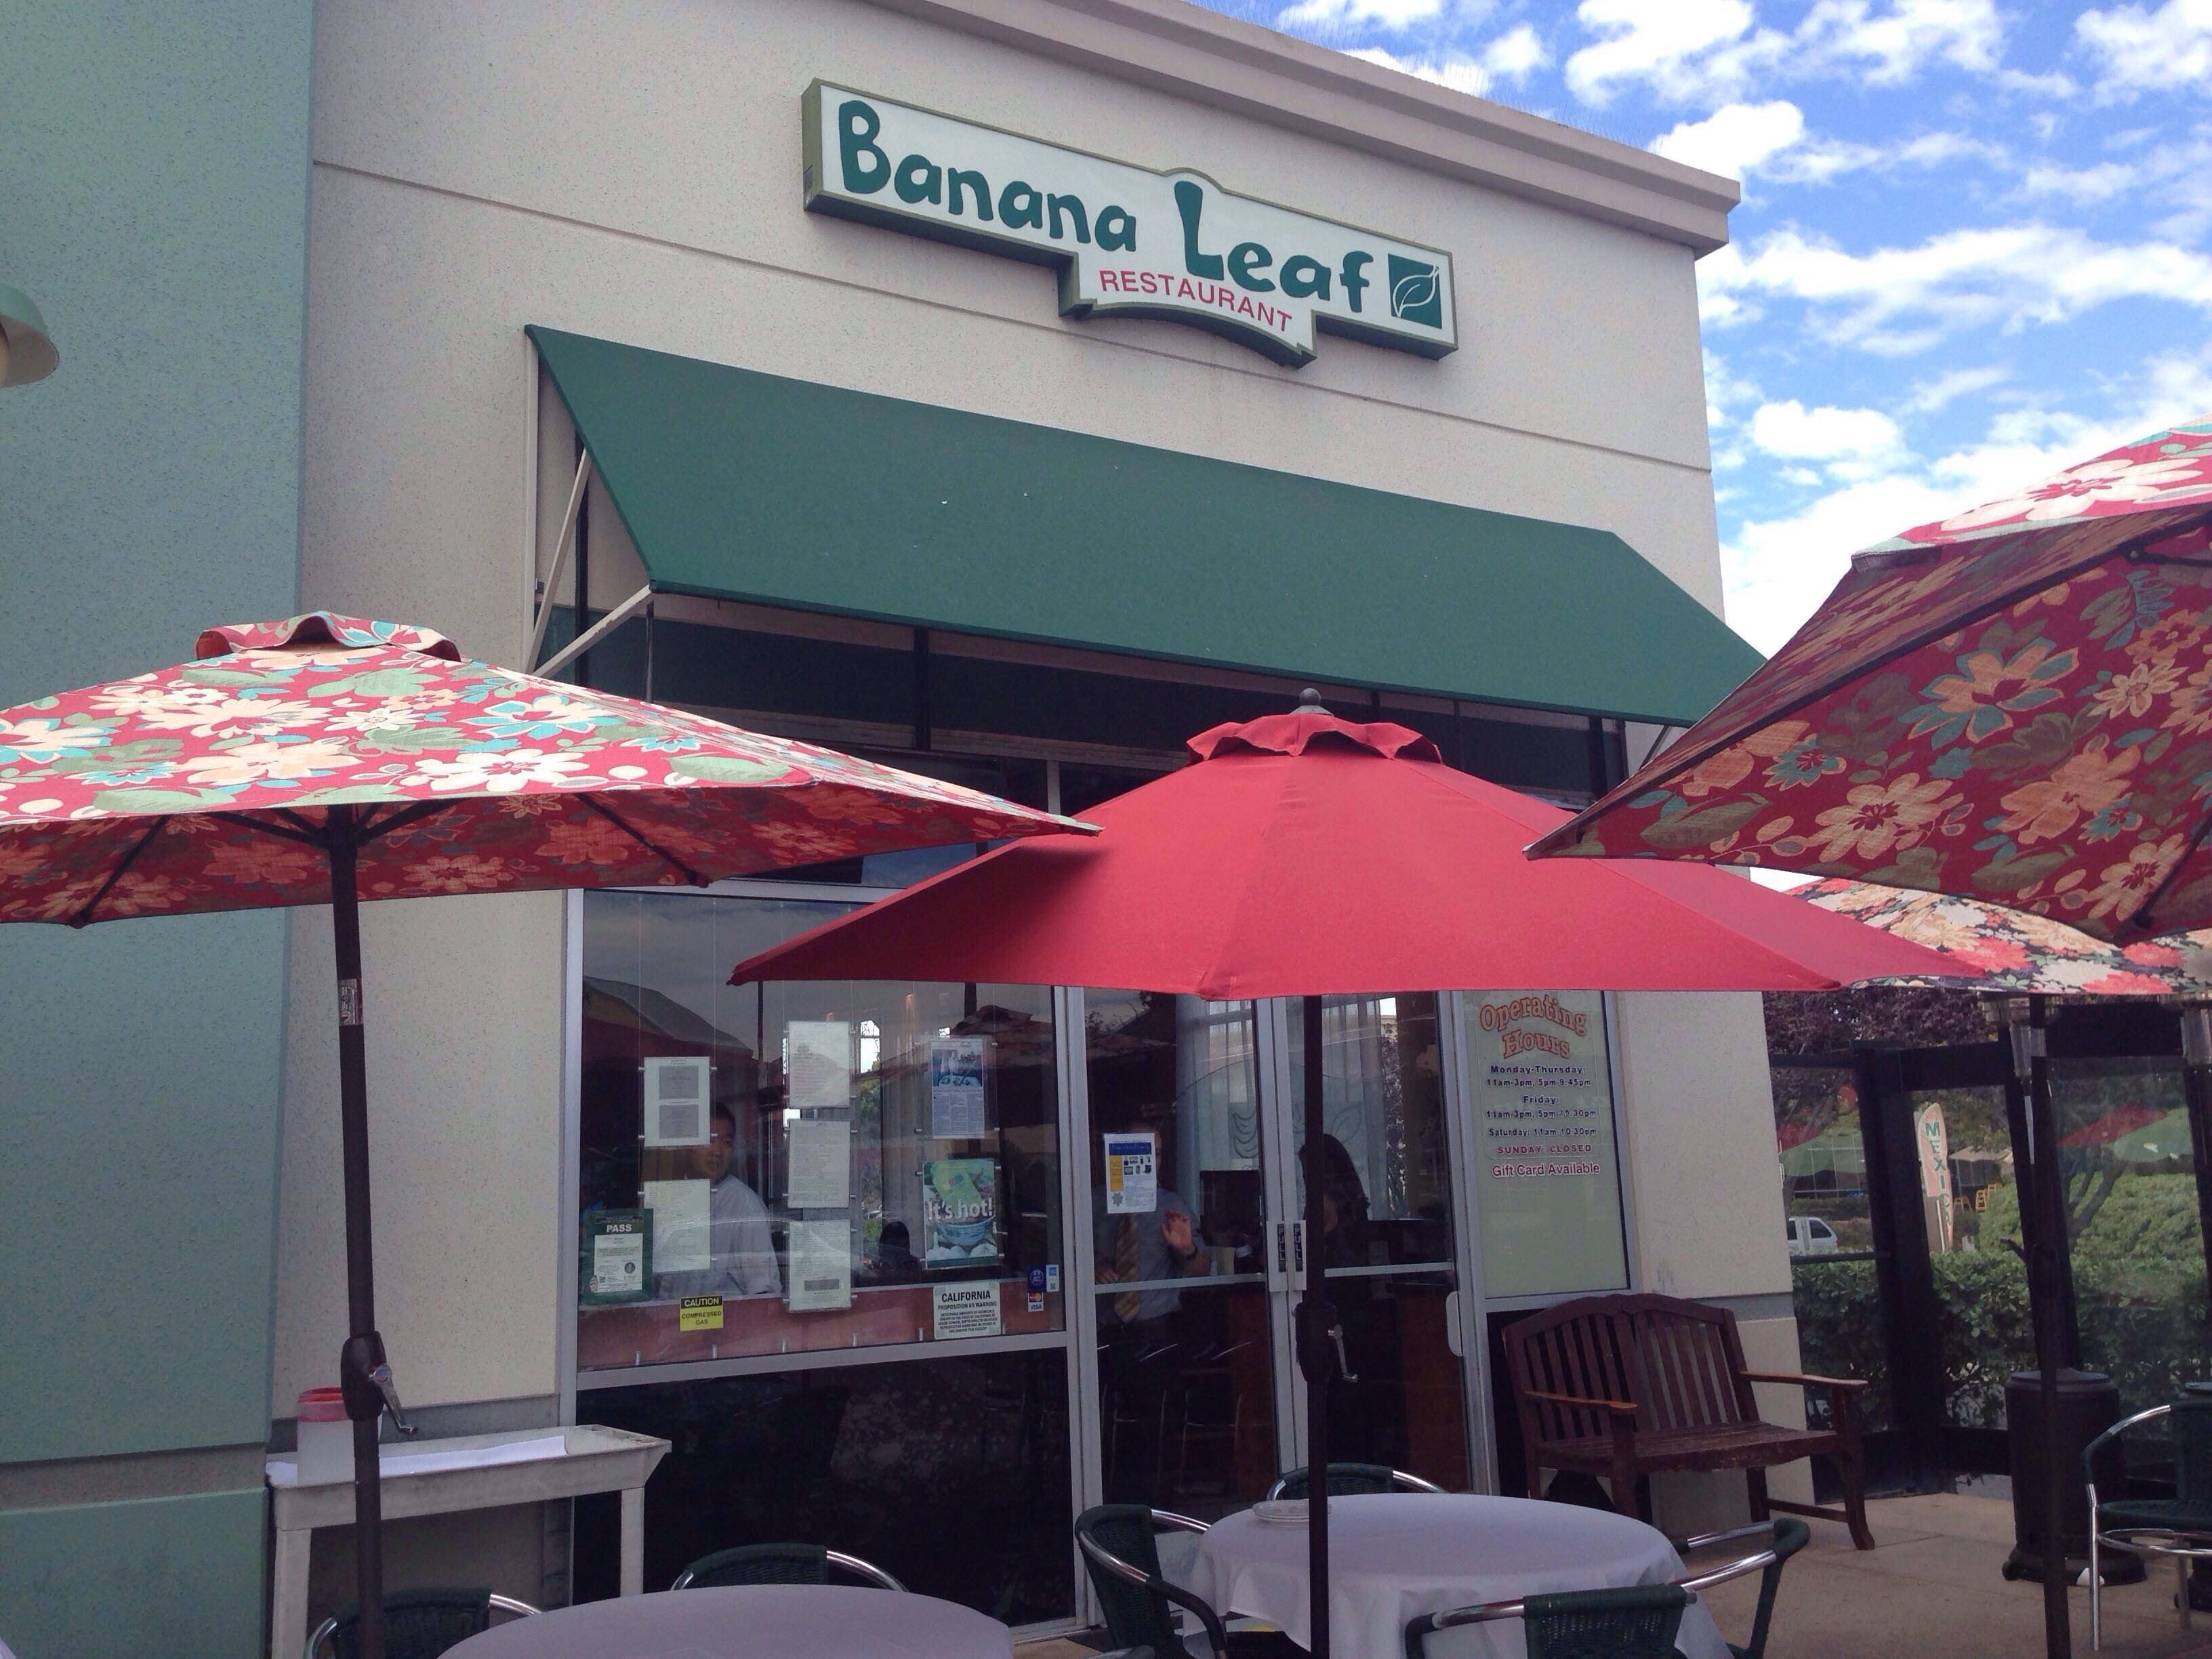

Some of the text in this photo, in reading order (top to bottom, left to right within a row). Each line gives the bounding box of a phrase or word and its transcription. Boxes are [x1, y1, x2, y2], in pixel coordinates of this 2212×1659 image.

[838, 100, 1374, 314] Banana Leaf
[1099, 270, 1293, 333] RESTAURANT
[1479, 994, 1587, 1037] Operating
[1502, 1029, 1570, 1059] Hours
[1550, 1144, 1592, 1153] CLOSED
[1492, 1163, 1600, 1177] Gift Card Available
[957, 1197, 993, 1218] hot!
[606, 1224, 632, 1233] PASS
[684, 1297, 720, 1307] CAUTION
[941, 1290, 991, 1303] CALIFORNIA
